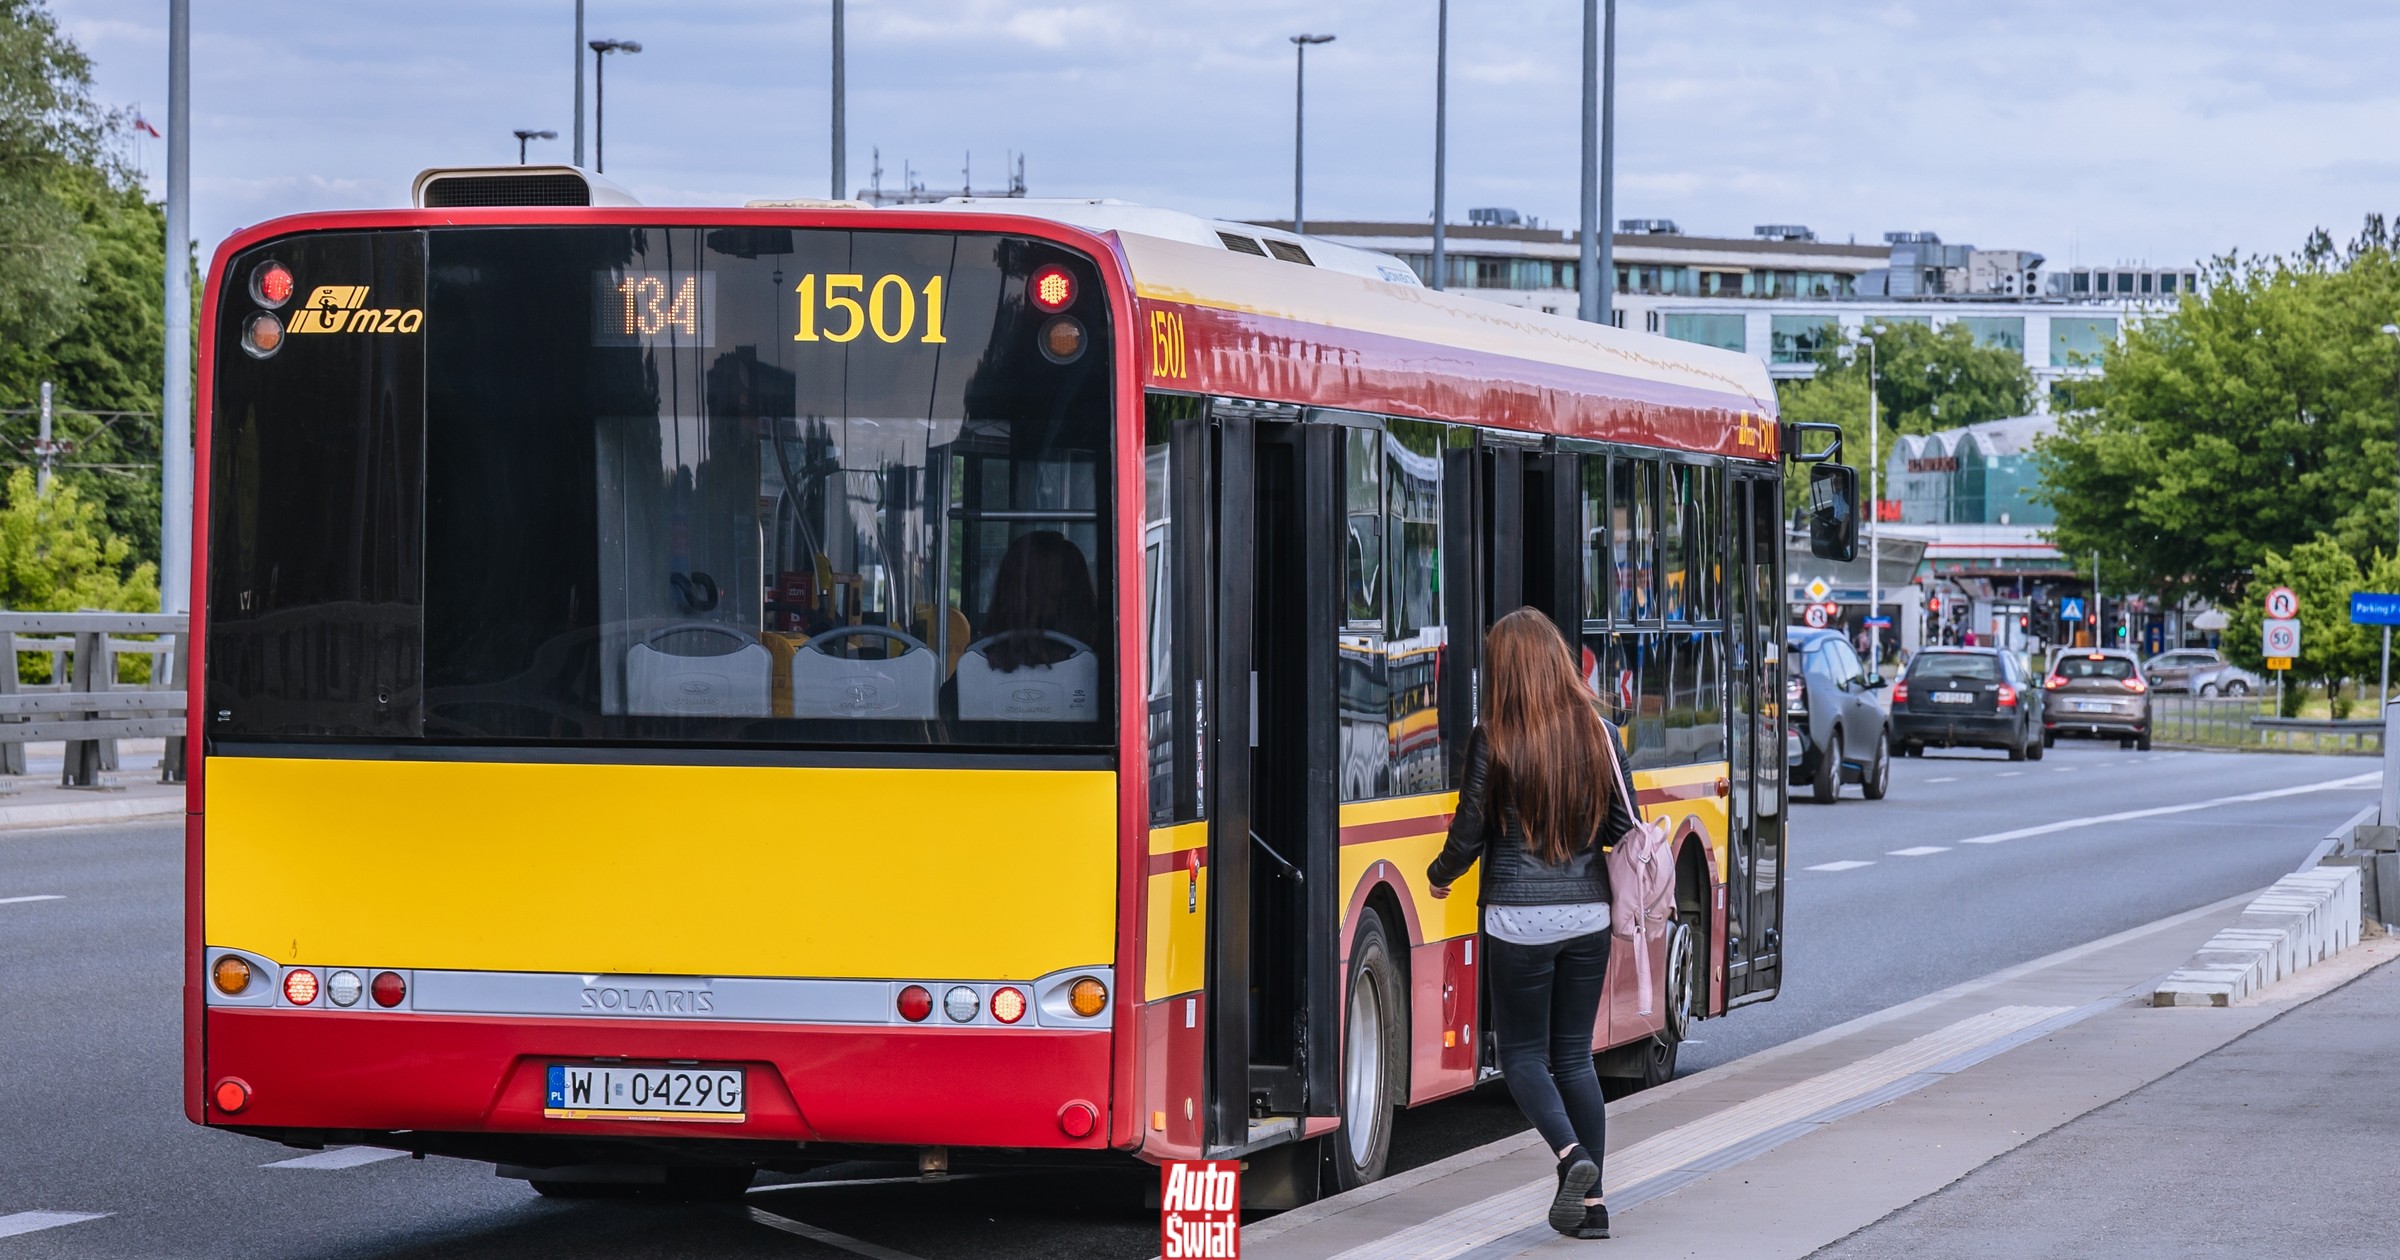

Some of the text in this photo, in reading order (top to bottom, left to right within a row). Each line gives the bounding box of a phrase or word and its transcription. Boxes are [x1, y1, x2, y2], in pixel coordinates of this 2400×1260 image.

[619, 277, 694, 334] 134
[794, 274, 946, 343] 1501
[346, 308, 423, 333] mza
[1151, 310, 1187, 378] 1501
[788, 588, 804, 596] ztm
[2356, 602, 2388, 615] Parking
[2274, 632, 2290, 645] 50
[580, 988, 714, 1014] SOLARIS
[551, 1091, 563, 1101] PL
[571, 1071, 737, 1107] WI 0429G
